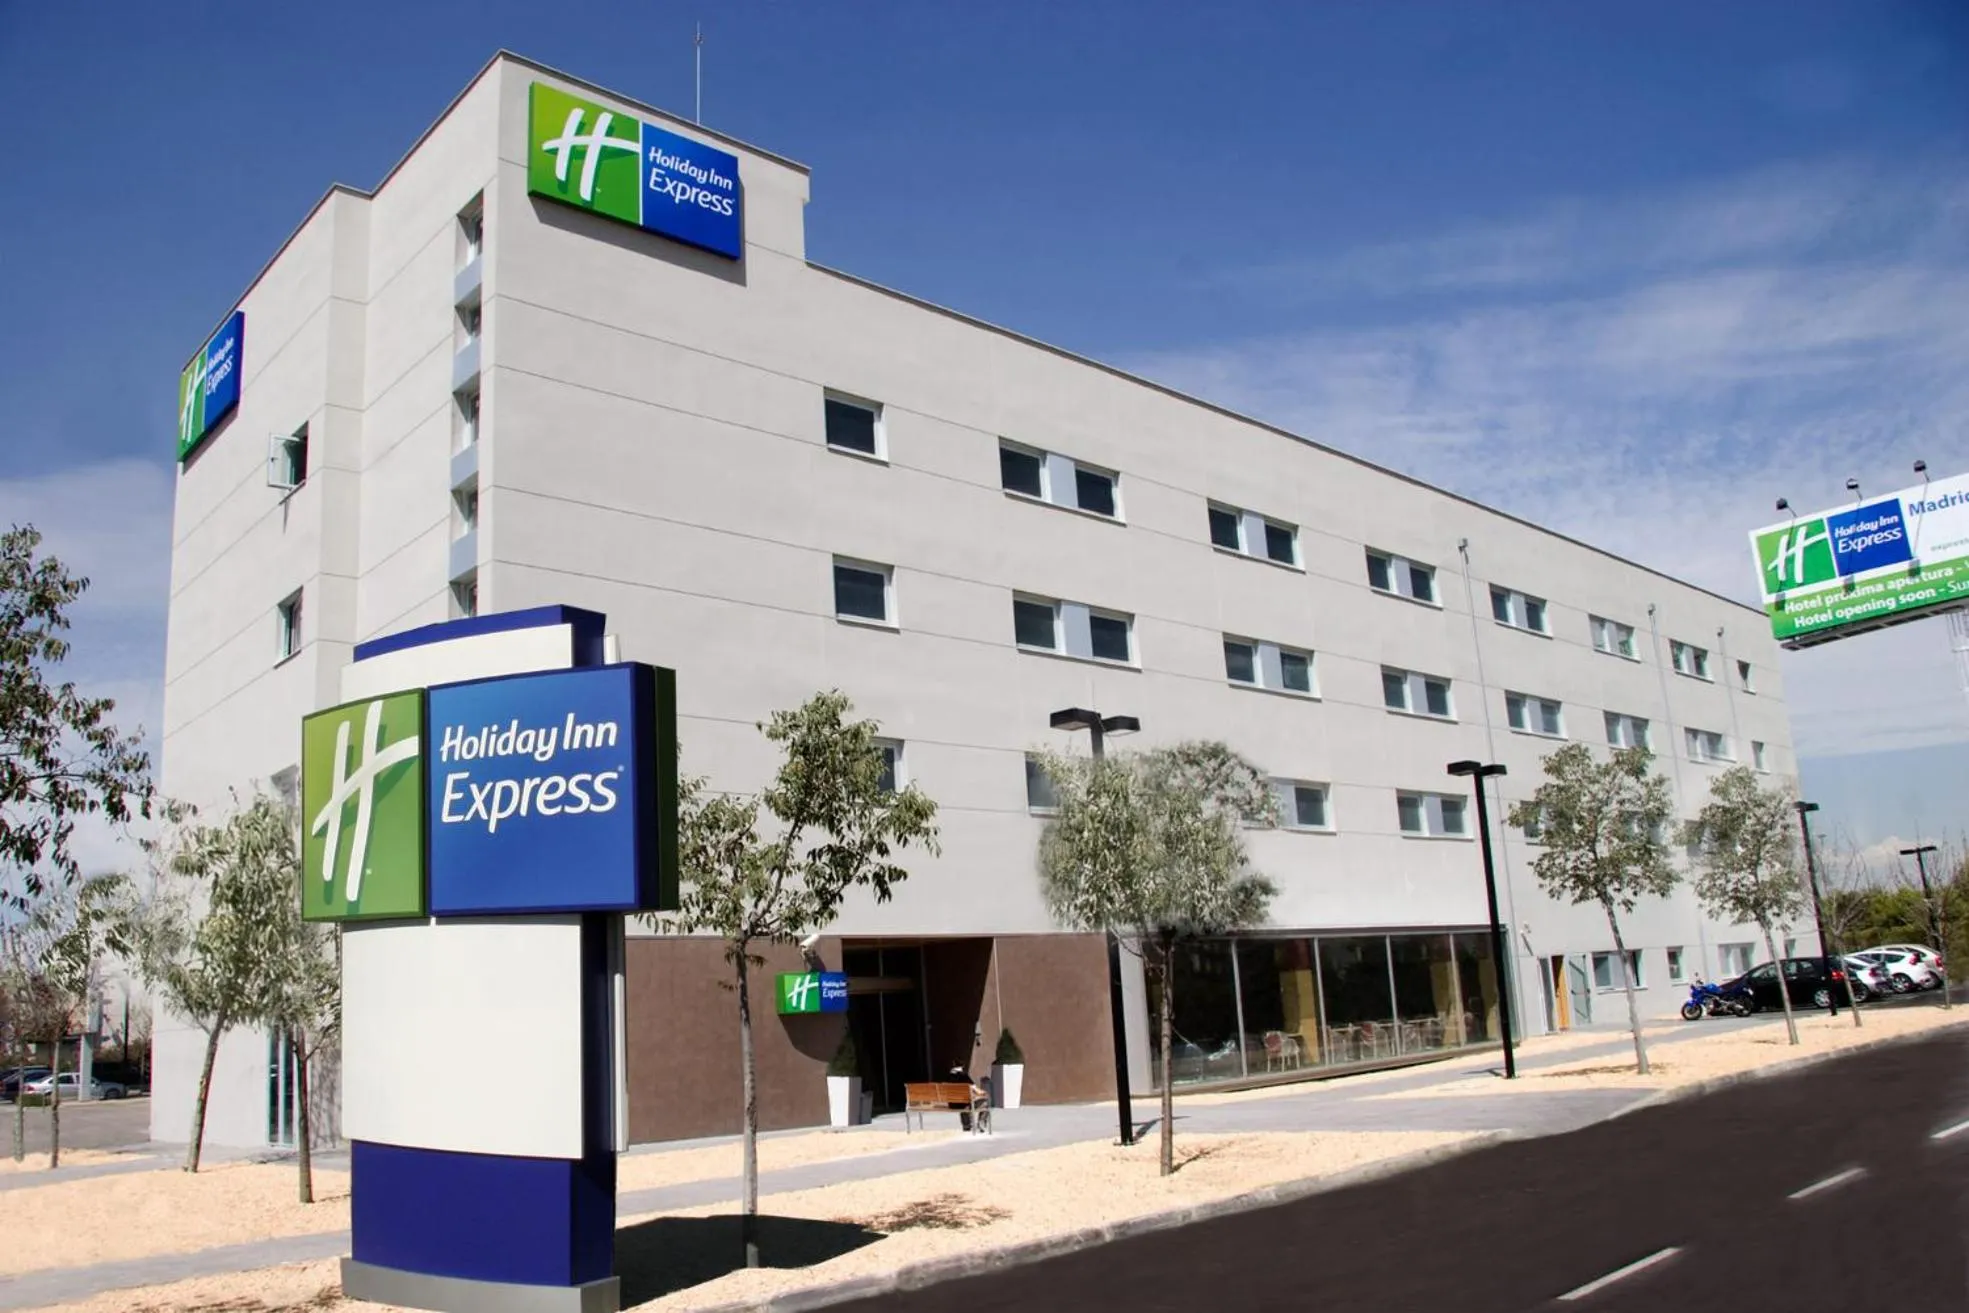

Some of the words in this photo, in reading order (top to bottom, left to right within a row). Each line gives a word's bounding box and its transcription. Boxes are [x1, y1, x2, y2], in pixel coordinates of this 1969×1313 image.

[649, 146, 708, 184] Holiday
[709, 169, 733, 190] Inn
[649, 168, 734, 216] Express
[1835, 520, 1878, 538] Holiday
[1879, 515, 1899, 526] Inn
[1838, 527, 1902, 553] Express
[1784, 595, 1823, 614] Hotel
[1794, 611, 1833, 629] Hotel
[1836, 595, 1896, 619] opening
[1900, 588, 1936, 603] soon
[440, 716, 558, 762] Holiday
[562, 712, 618, 750] Inn
[441, 770, 619, 834] Express
